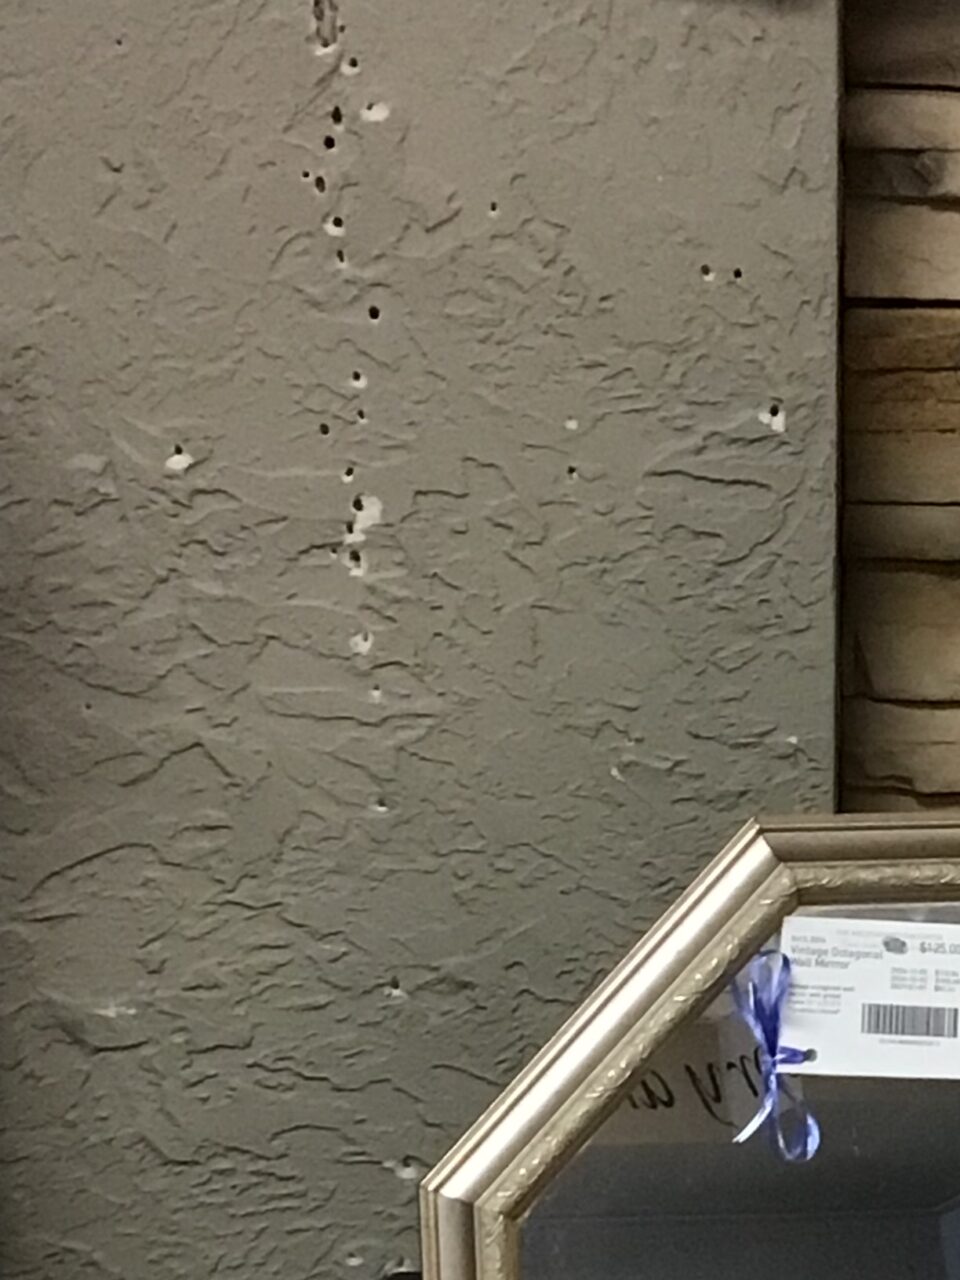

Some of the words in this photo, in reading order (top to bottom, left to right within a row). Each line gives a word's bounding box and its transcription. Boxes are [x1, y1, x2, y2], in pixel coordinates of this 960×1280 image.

[790, 945, 829, 958] Vintage
[831, 947, 883, 961] Octagonal
[814, 957, 850, 969] Mirror
